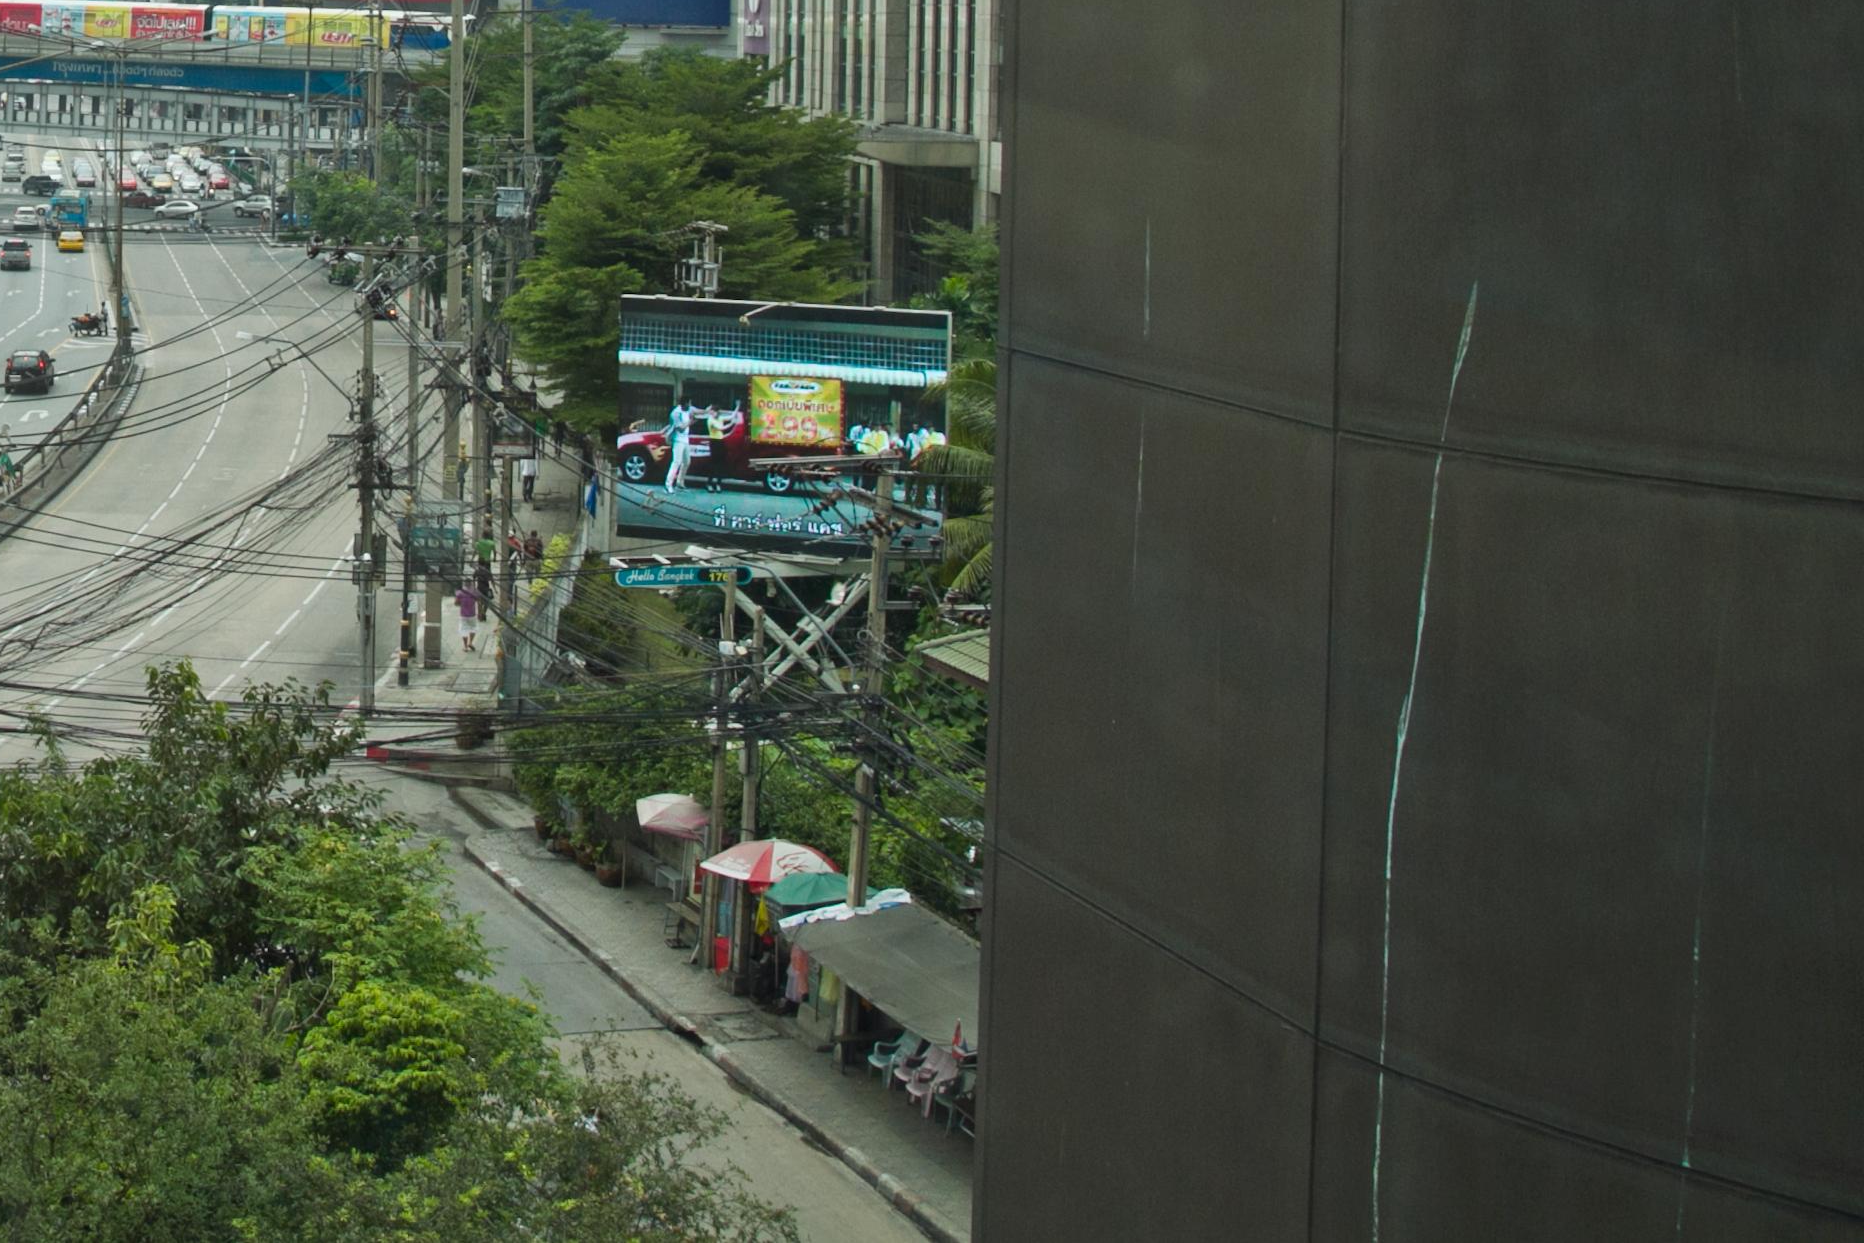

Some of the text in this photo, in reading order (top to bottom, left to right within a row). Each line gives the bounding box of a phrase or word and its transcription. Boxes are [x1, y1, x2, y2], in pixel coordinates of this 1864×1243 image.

[625, 568, 730, 585] Hello Bangkok 176
